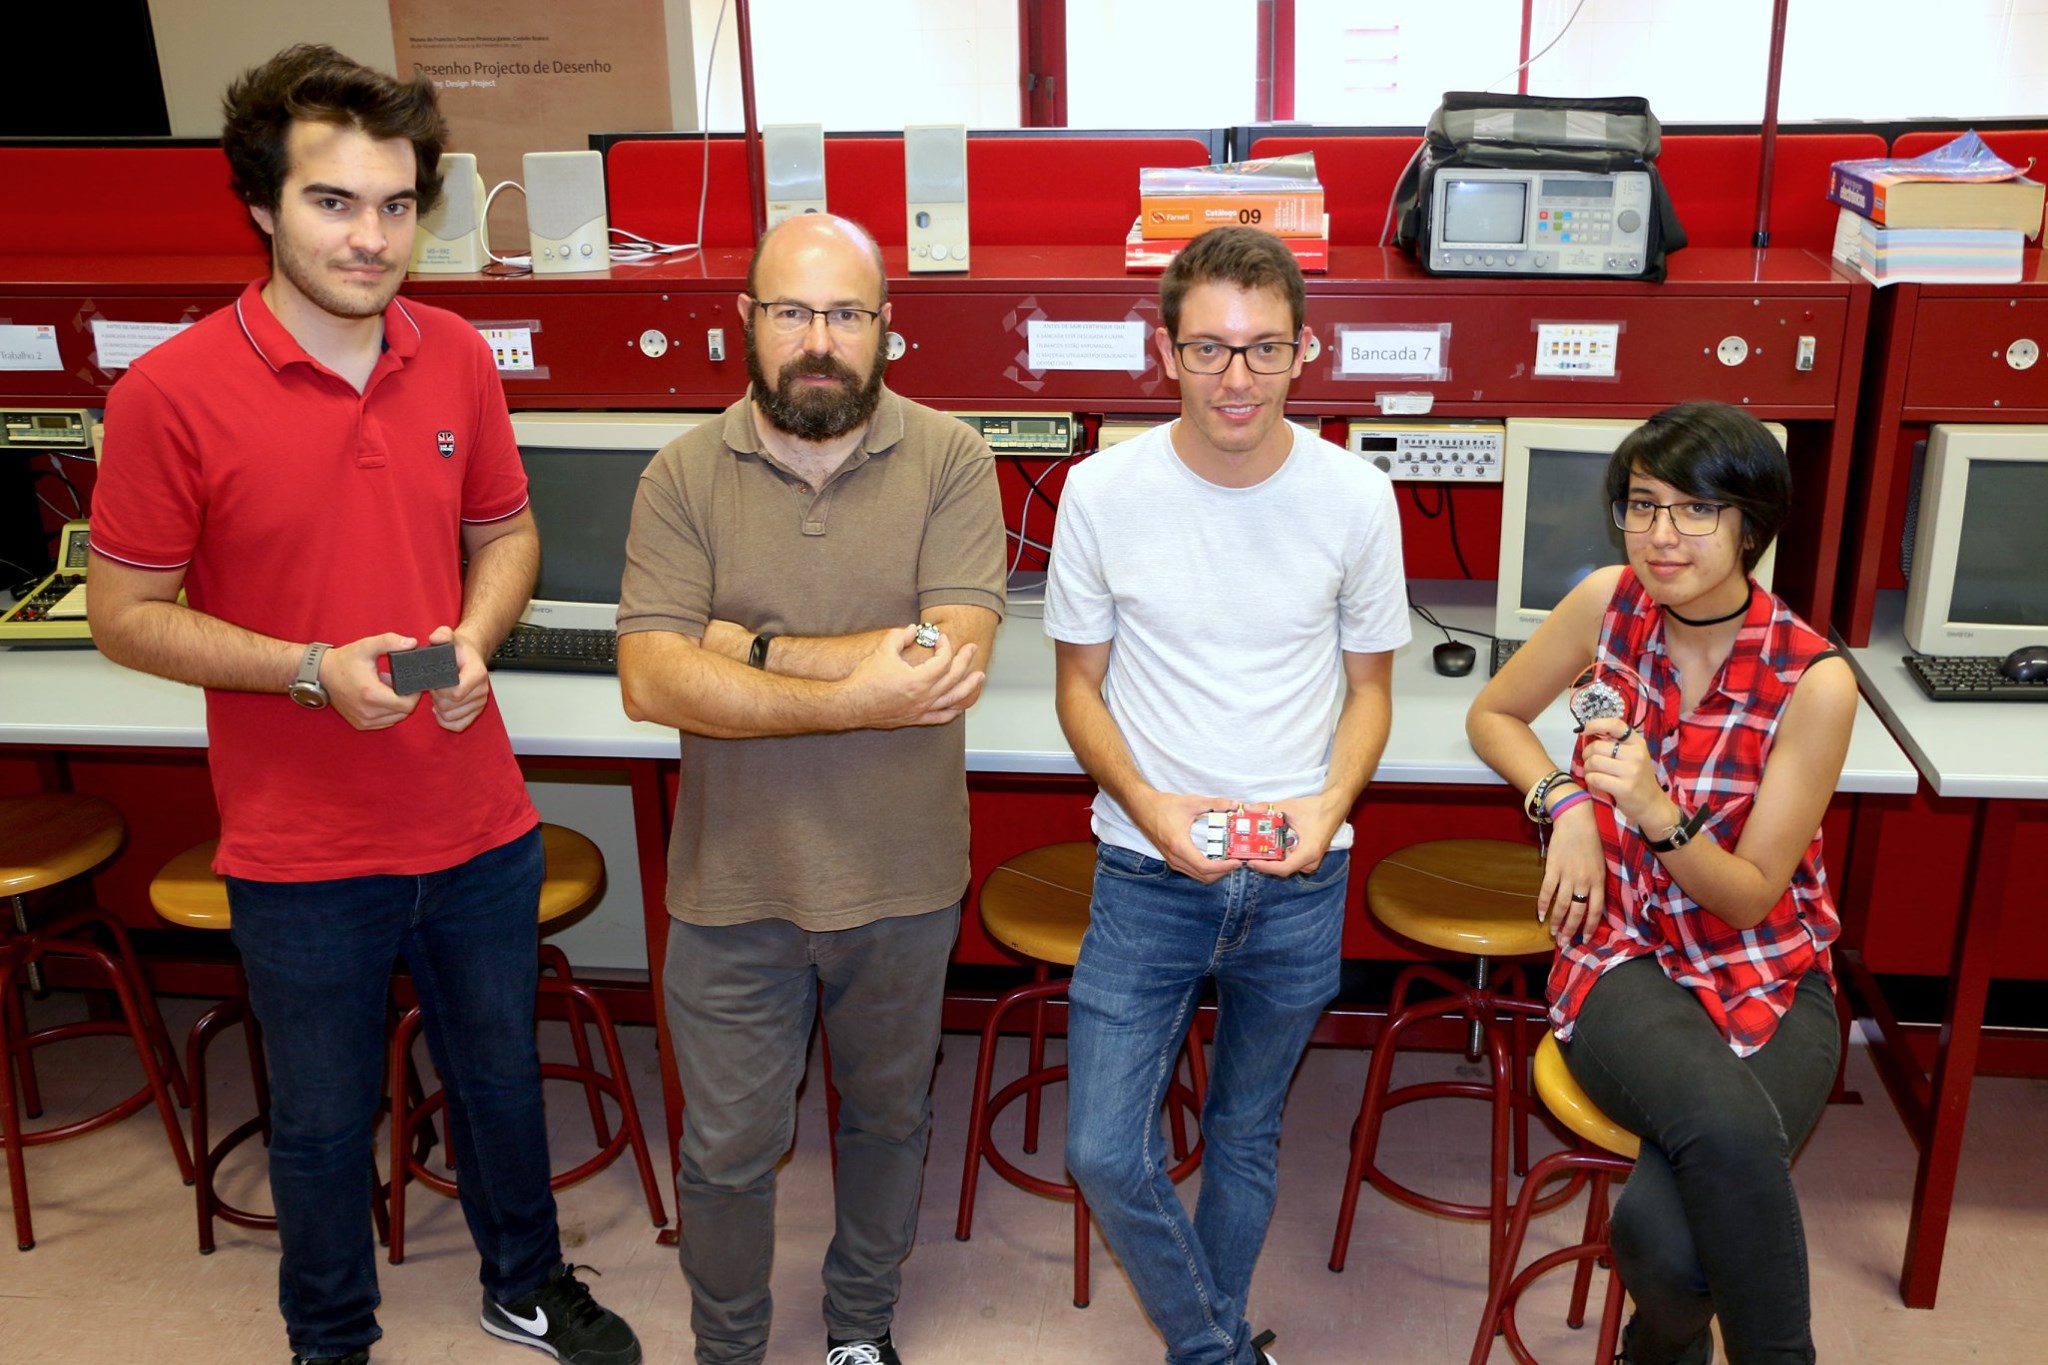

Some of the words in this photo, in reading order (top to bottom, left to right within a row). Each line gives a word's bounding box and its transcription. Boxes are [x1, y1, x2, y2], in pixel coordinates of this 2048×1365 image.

[474, 61, 530, 77] Projecto
[533, 60, 549, 74] de
[553, 59, 612, 74] Desenho
[445, 80, 470, 89] Design
[471, 80, 496, 89] Project
[1166, 213, 1190, 221] Farnell
[1205, 208, 1238, 218] Catálogo
[1239, 209, 1262, 225] 09
[36, 351, 42, 360] 2
[1351, 346, 1417, 361] Bancada
[1423, 347, 1432, 361] 7
